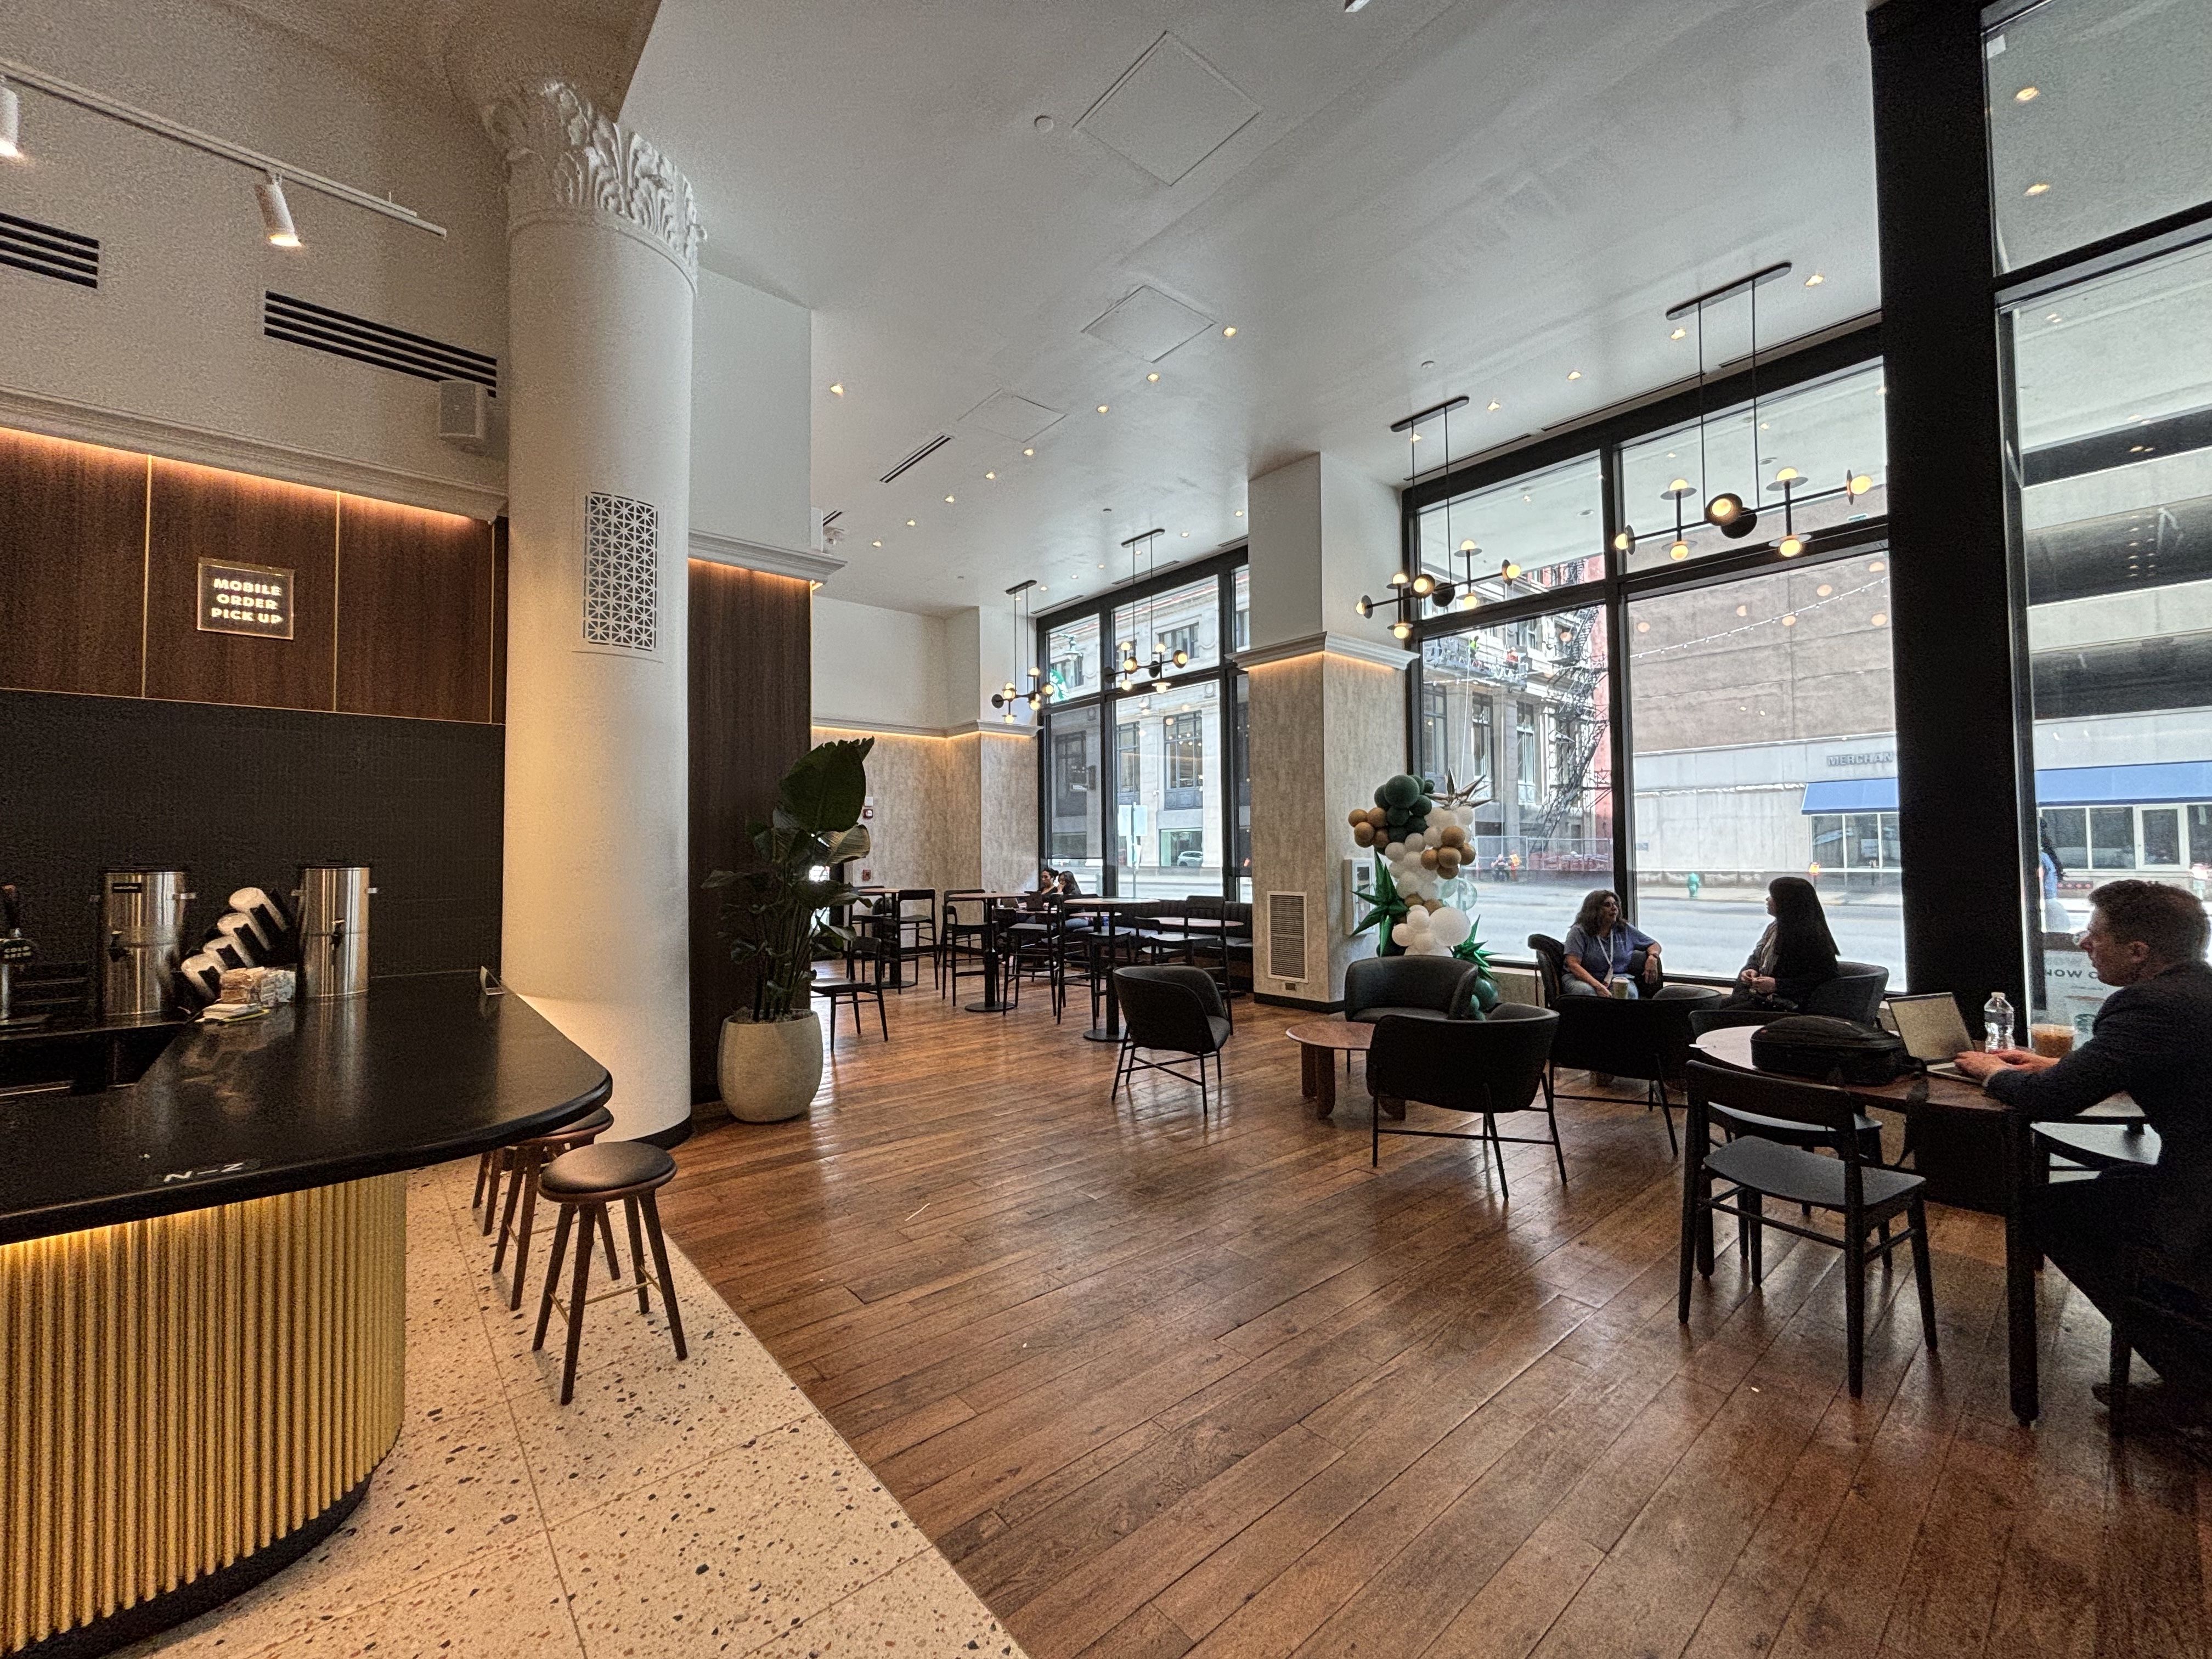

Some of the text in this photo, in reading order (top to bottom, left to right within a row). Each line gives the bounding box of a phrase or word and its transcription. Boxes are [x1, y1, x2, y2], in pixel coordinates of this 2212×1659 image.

[213, 578, 282, 596] MOBILE
[216, 594, 278, 610] ORDER
[211, 607, 283, 624] PICK UP
[1827, 752, 1895, 766] MERCHAN
